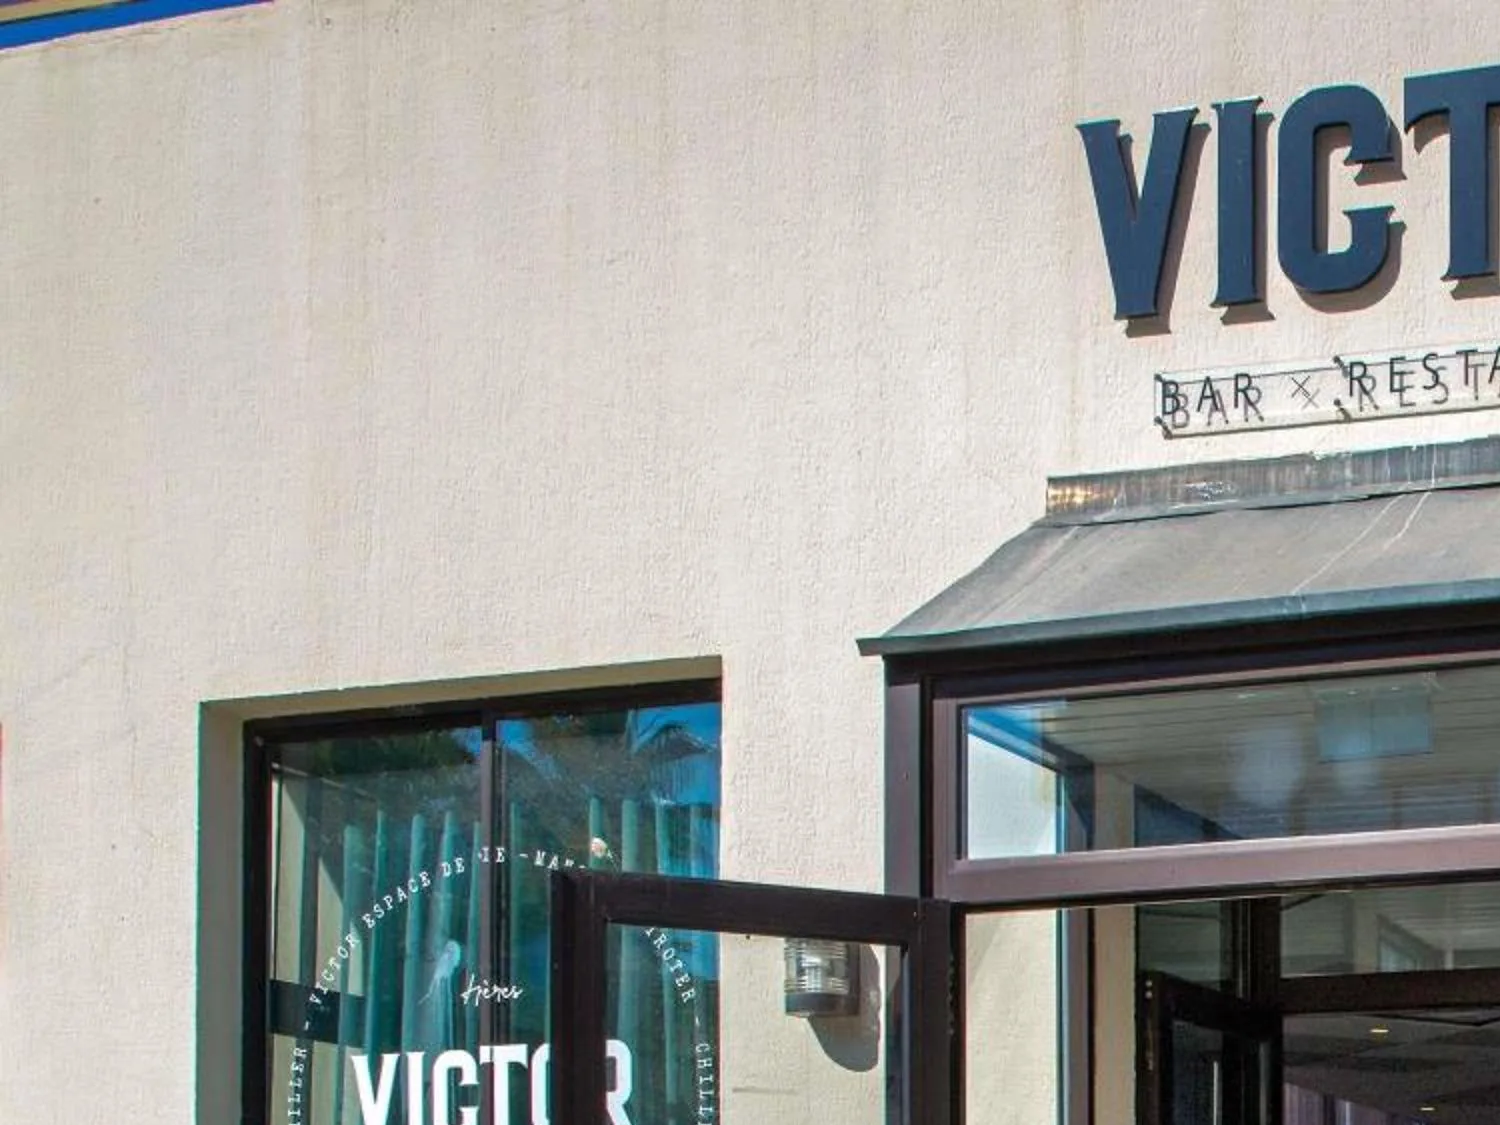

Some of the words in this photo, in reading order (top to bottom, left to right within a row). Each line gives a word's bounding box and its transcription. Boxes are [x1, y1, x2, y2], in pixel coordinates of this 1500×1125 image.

[1161, 372, 1256, 417] BAR
[362, 870, 432, 929] ESPACE
[441, 856, 466, 878] DE
[477, 846, 506, 864] IE
[644, 926, 696, 1003] IROTER
